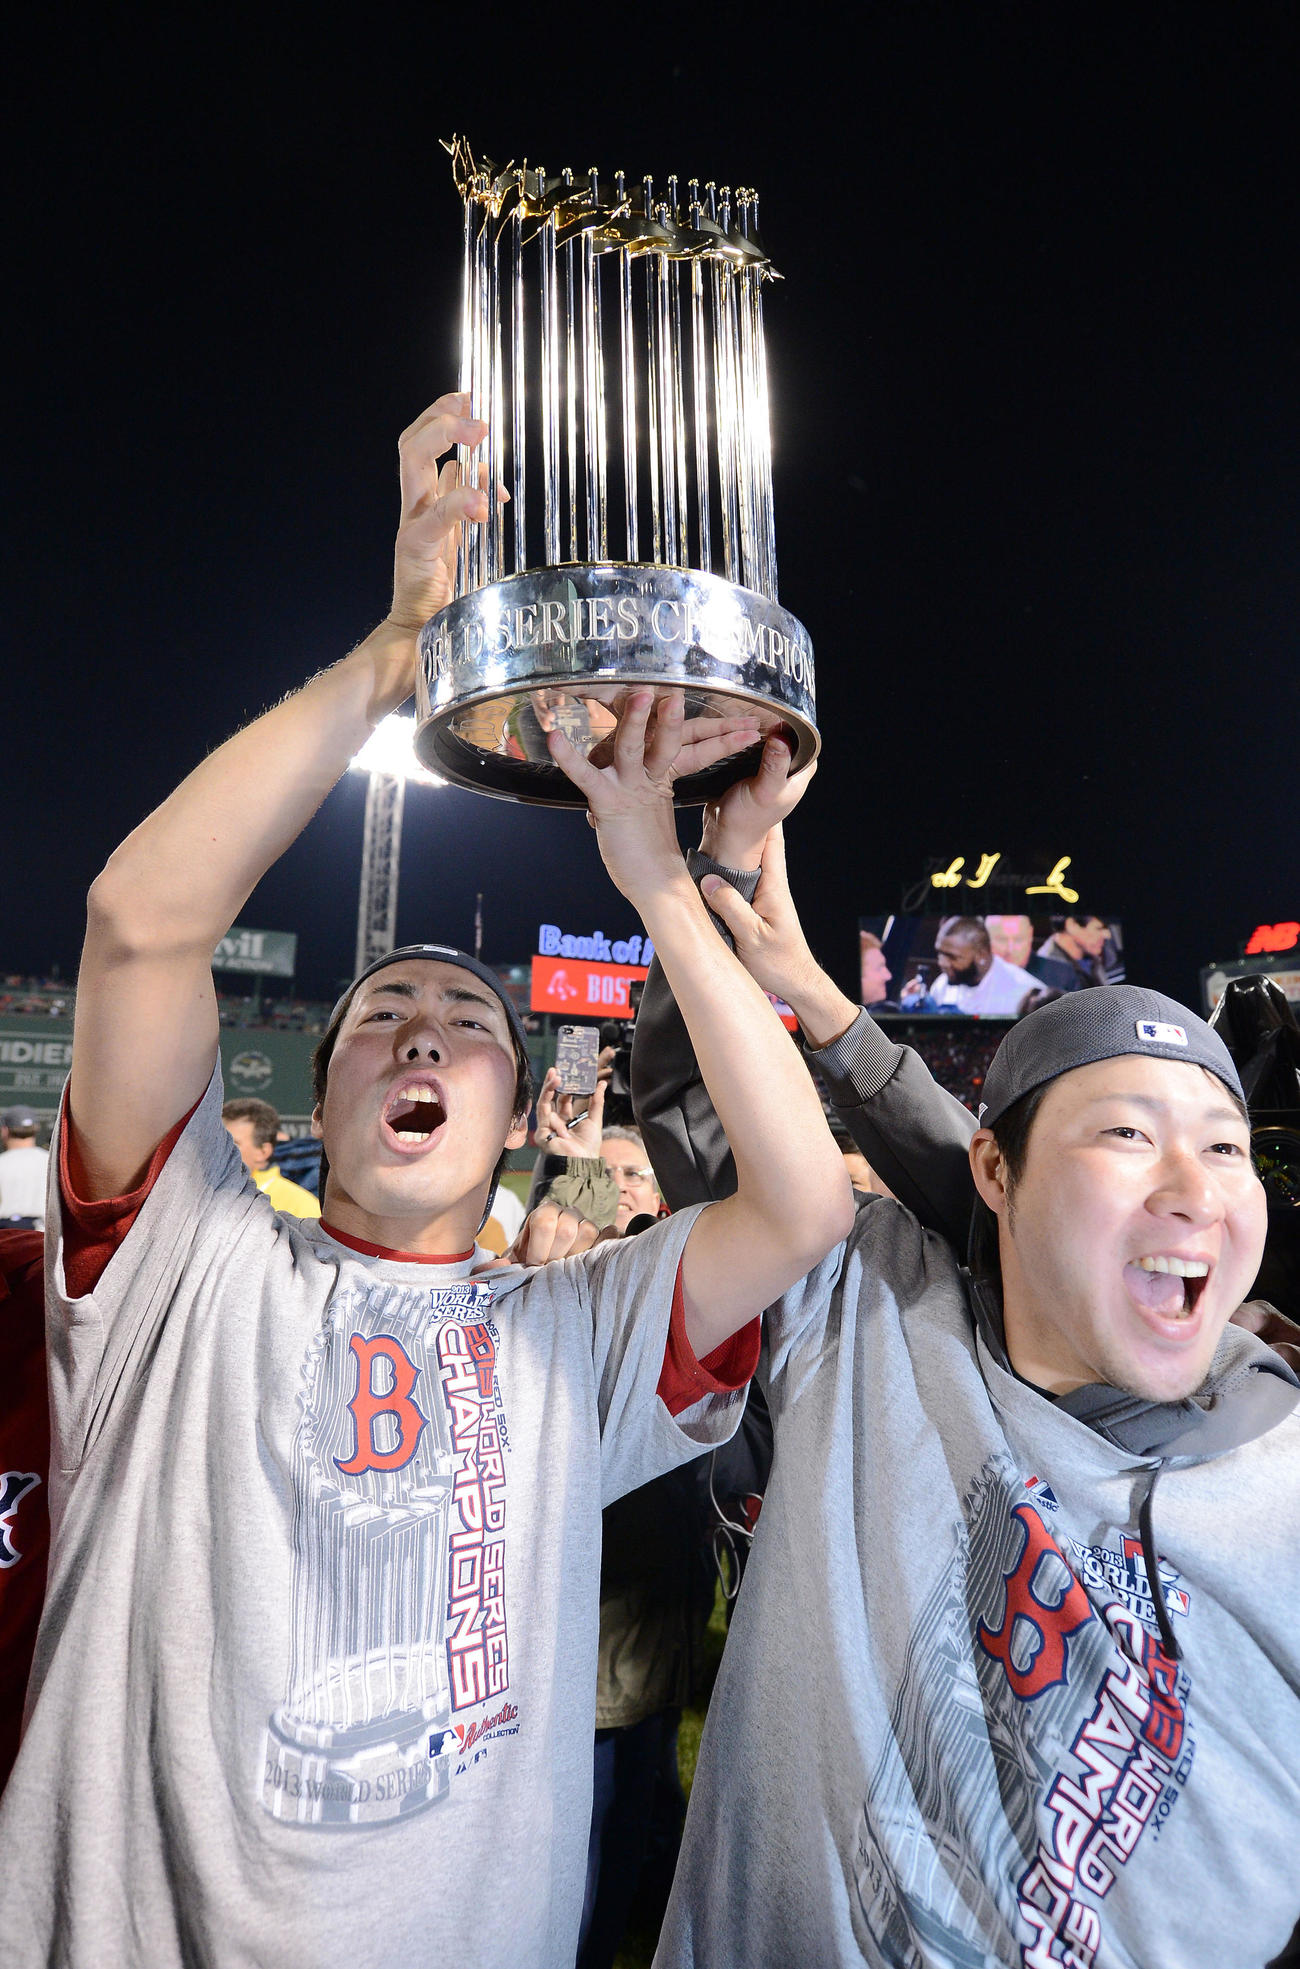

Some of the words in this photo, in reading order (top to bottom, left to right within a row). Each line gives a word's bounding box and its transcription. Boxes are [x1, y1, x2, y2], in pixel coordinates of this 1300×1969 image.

[421, 622, 484, 688] ORLD
[495, 597, 638, 655] SERIES
[539, 924, 611, 961] Bank
[611, 936, 643, 965] of
[332, 1331, 430, 1476] B
[496, 1412, 511, 1449] SOX
[478, 1401, 507, 1534] WORLD
[435, 1319, 490, 1713] CHAMPIONS
[1091, 1545, 1124, 1568] 2013
[480, 1536, 509, 1697] SERIES
[976, 1502, 1097, 1703] B
[459, 1702, 519, 1755] Authentic
[265, 1760, 301, 1798] 2013
[375, 1756, 433, 1801] SERIES
[1076, 1741, 1173, 1900] WORLD
[1151, 1784, 1180, 1833] SOX
